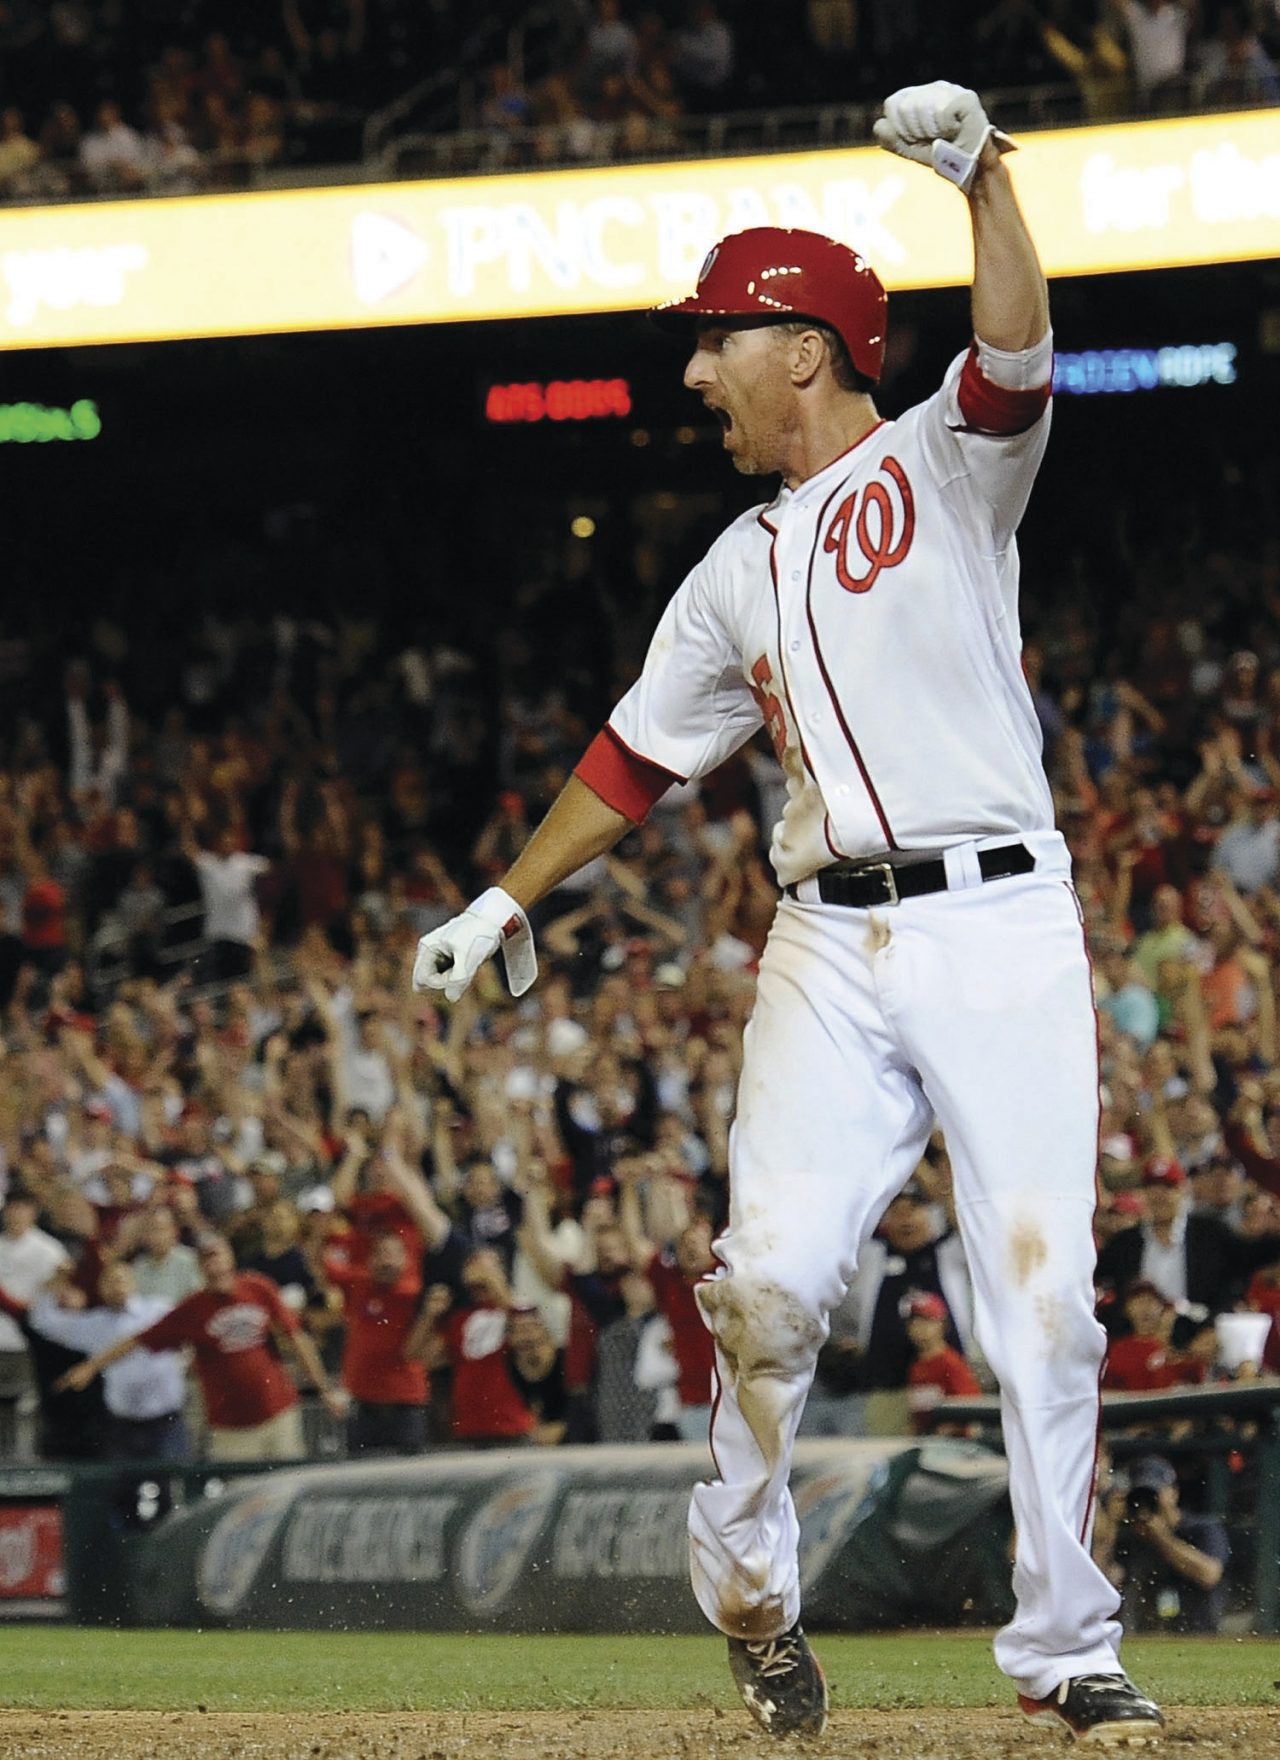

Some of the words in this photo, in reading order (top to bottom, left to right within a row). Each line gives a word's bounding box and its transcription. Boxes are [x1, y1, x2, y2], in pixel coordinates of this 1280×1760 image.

[1079, 151, 1182, 233] for
[438, 196, 645, 297] PNC
[824, 455, 915, 594] W
